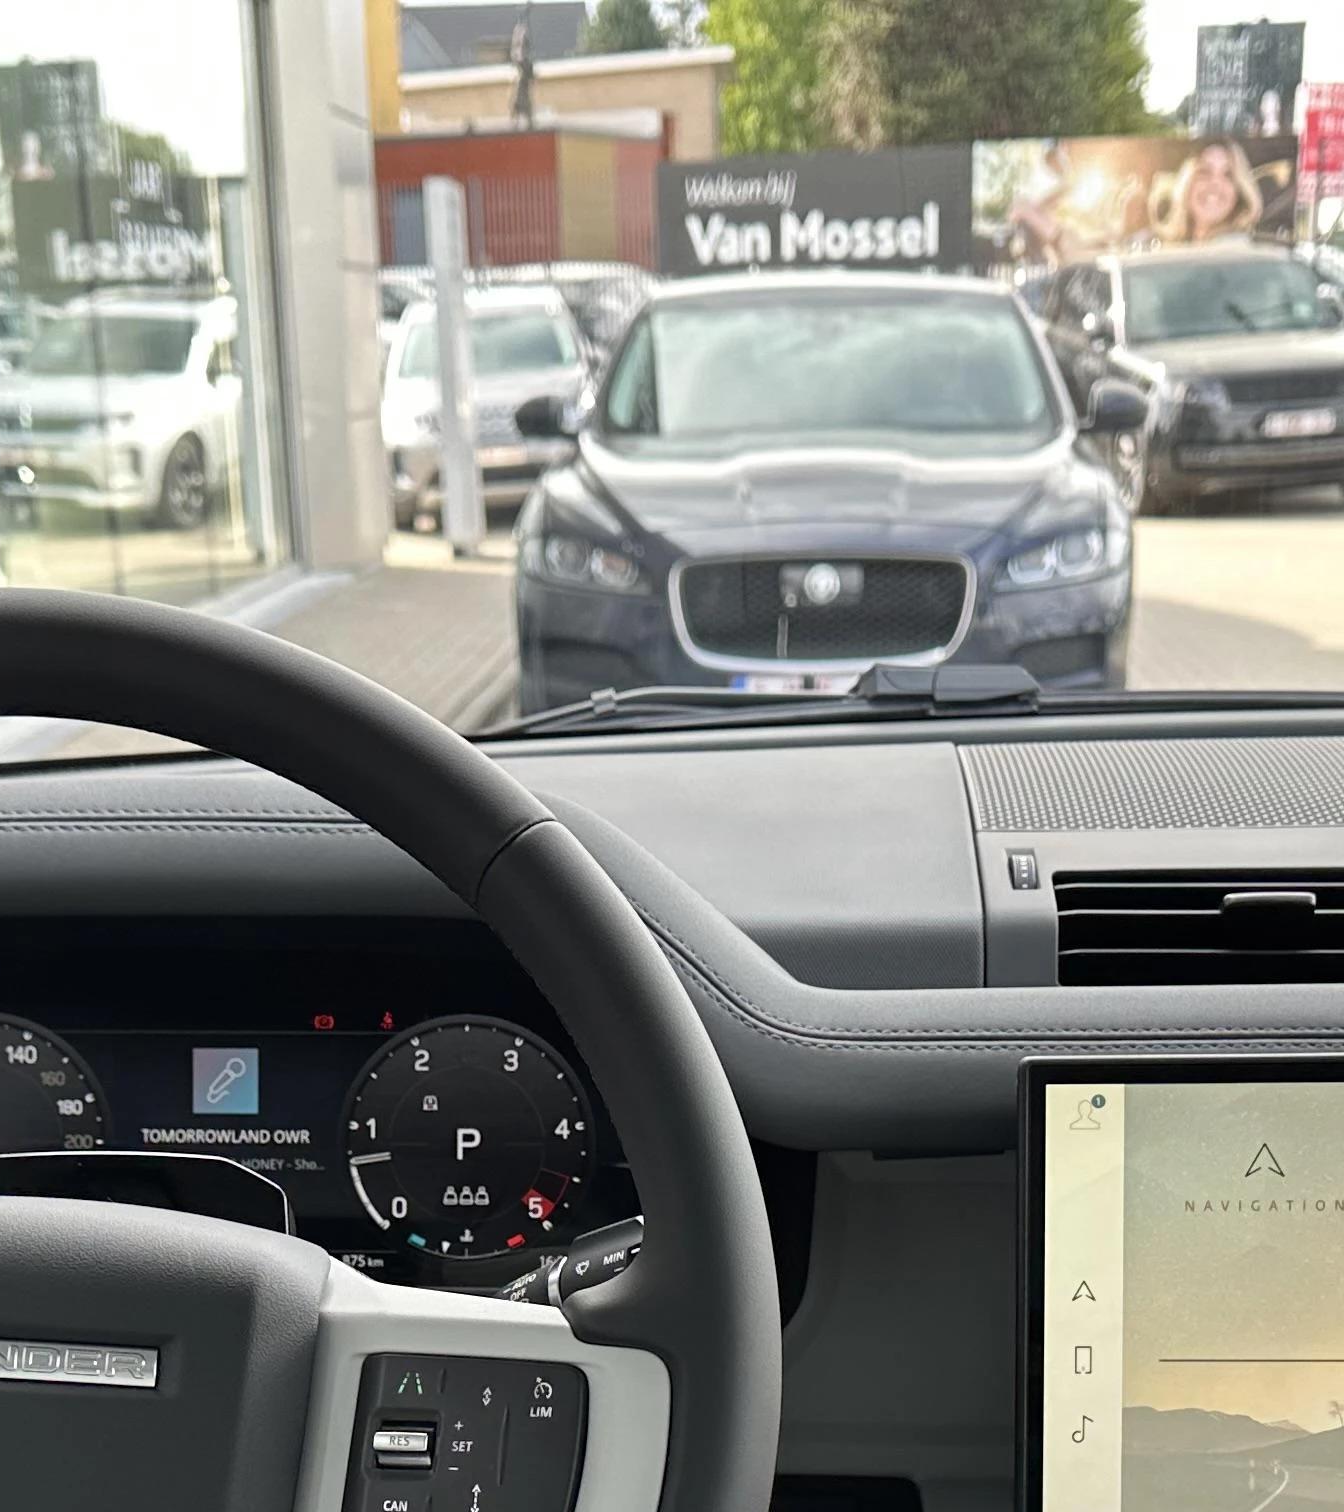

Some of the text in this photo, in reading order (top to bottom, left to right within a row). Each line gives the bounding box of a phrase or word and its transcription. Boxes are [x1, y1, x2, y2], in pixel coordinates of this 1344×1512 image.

[685, 201, 940, 265] Van Mossel
[6, 1045, 37, 1065] 140
[414, 1050, 430, 1072] 2
[504, 1050, 519, 1072] 3
[40, 1071, 65, 1087] 160
[57, 1099, 83, 1115] 180
[141, 1128, 310, 1144] TOMORROWLAND OWR
[366, 1118, 377, 1139] 1
[554, 1118, 571, 1140] 4
[64, 1134, 93, 1149] 200
[456, 1128, 482, 1160] P
[391, 1197, 408, 1218] 0
[527, 1197, 544, 1219] 5
[368, 1256, 385, 1268] km
[603, 1250, 625, 1265] MIN
[513, 1274, 537, 1290] AUTO
[510, 1288, 527, 1301] OFF
[530, 1407, 552, 1418] LIM
[389, 1436, 410, 1447] RES
[452, 1441, 473, 1452] SET
[383, 1501, 407, 1512] CAN
